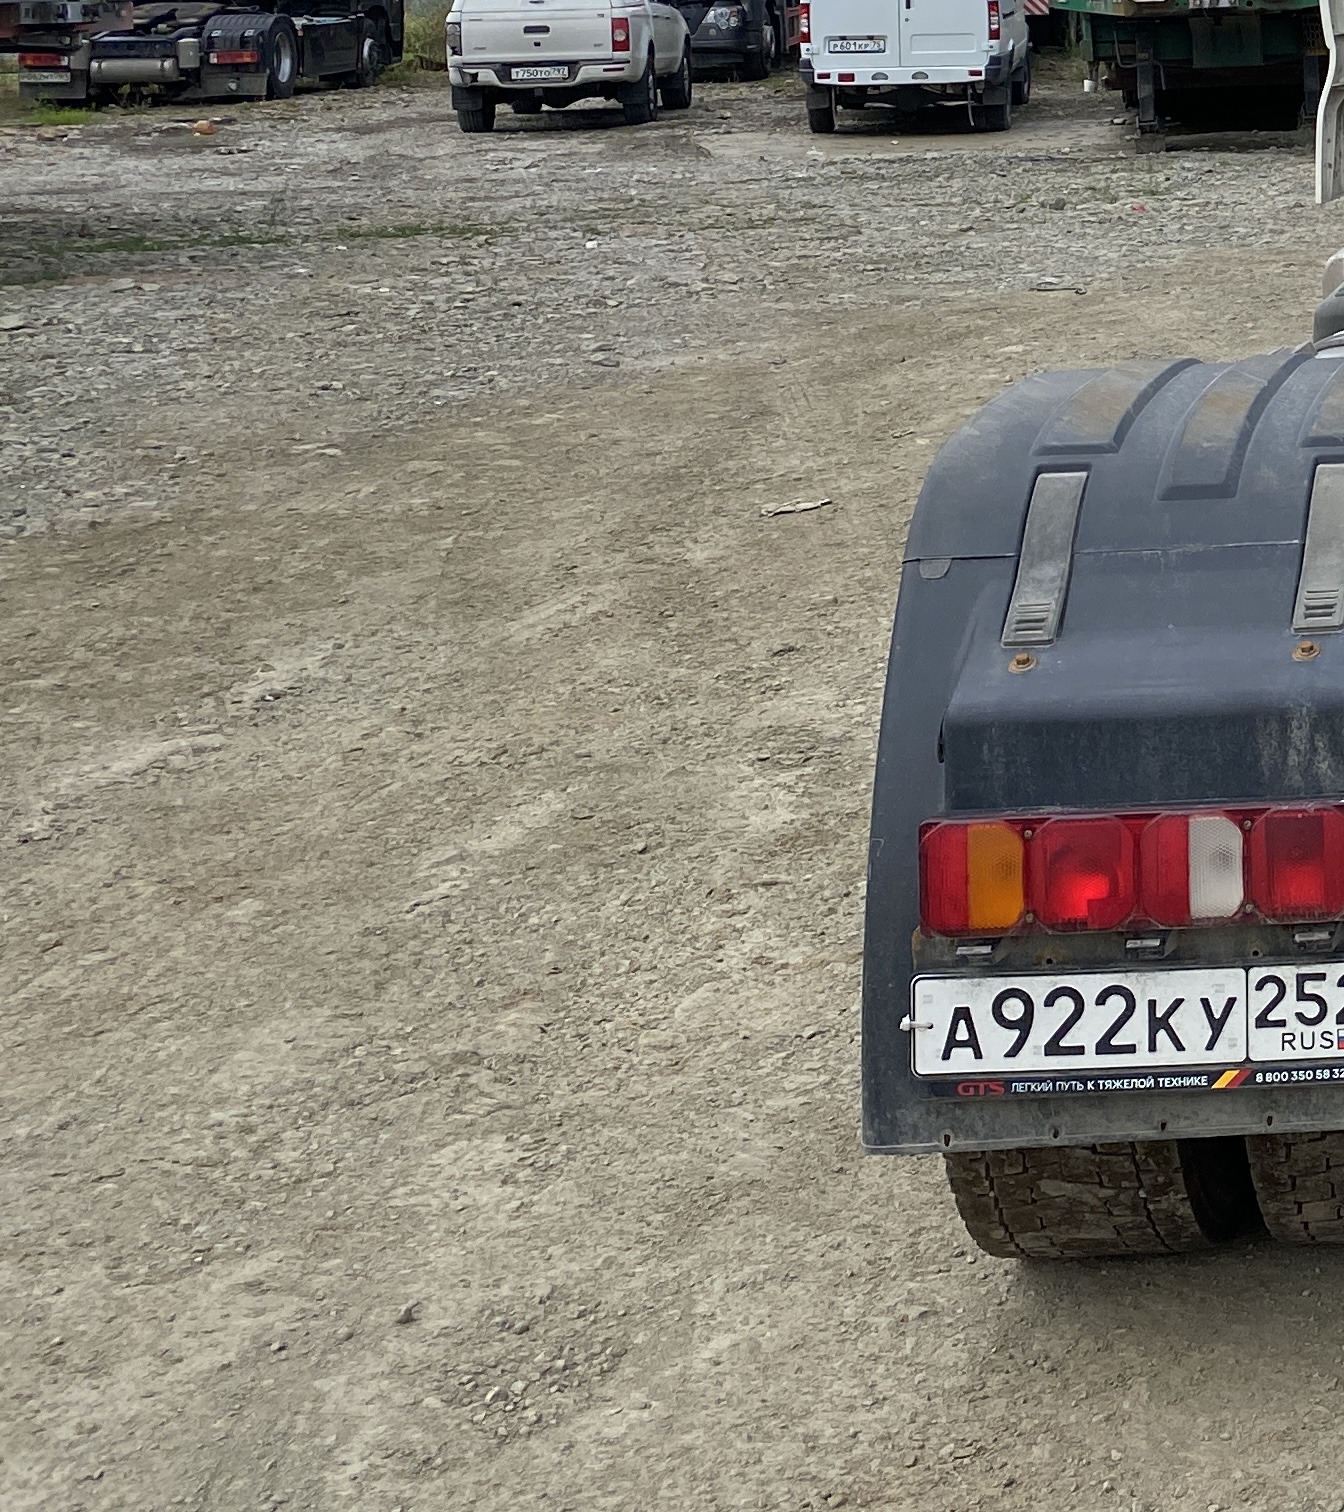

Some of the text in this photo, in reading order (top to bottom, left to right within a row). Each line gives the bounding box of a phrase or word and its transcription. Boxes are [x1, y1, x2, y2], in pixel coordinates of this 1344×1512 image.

[940, 984, 1237, 1061] А922КУ
[1281, 1029, 1334, 1051] RUS
[957, 1075, 1209, 1096] GTS ЛЕГКИЙ ПУТЬ К ТЯЖЕЛОЙ ТЕХНИКЕ
[1255, 1073, 1263, 1083] 8
[1265, 1072, 1289, 1082] 800
[1290, 1070, 1314, 1081] 350
[1315, 1069, 1331, 1080] 58
